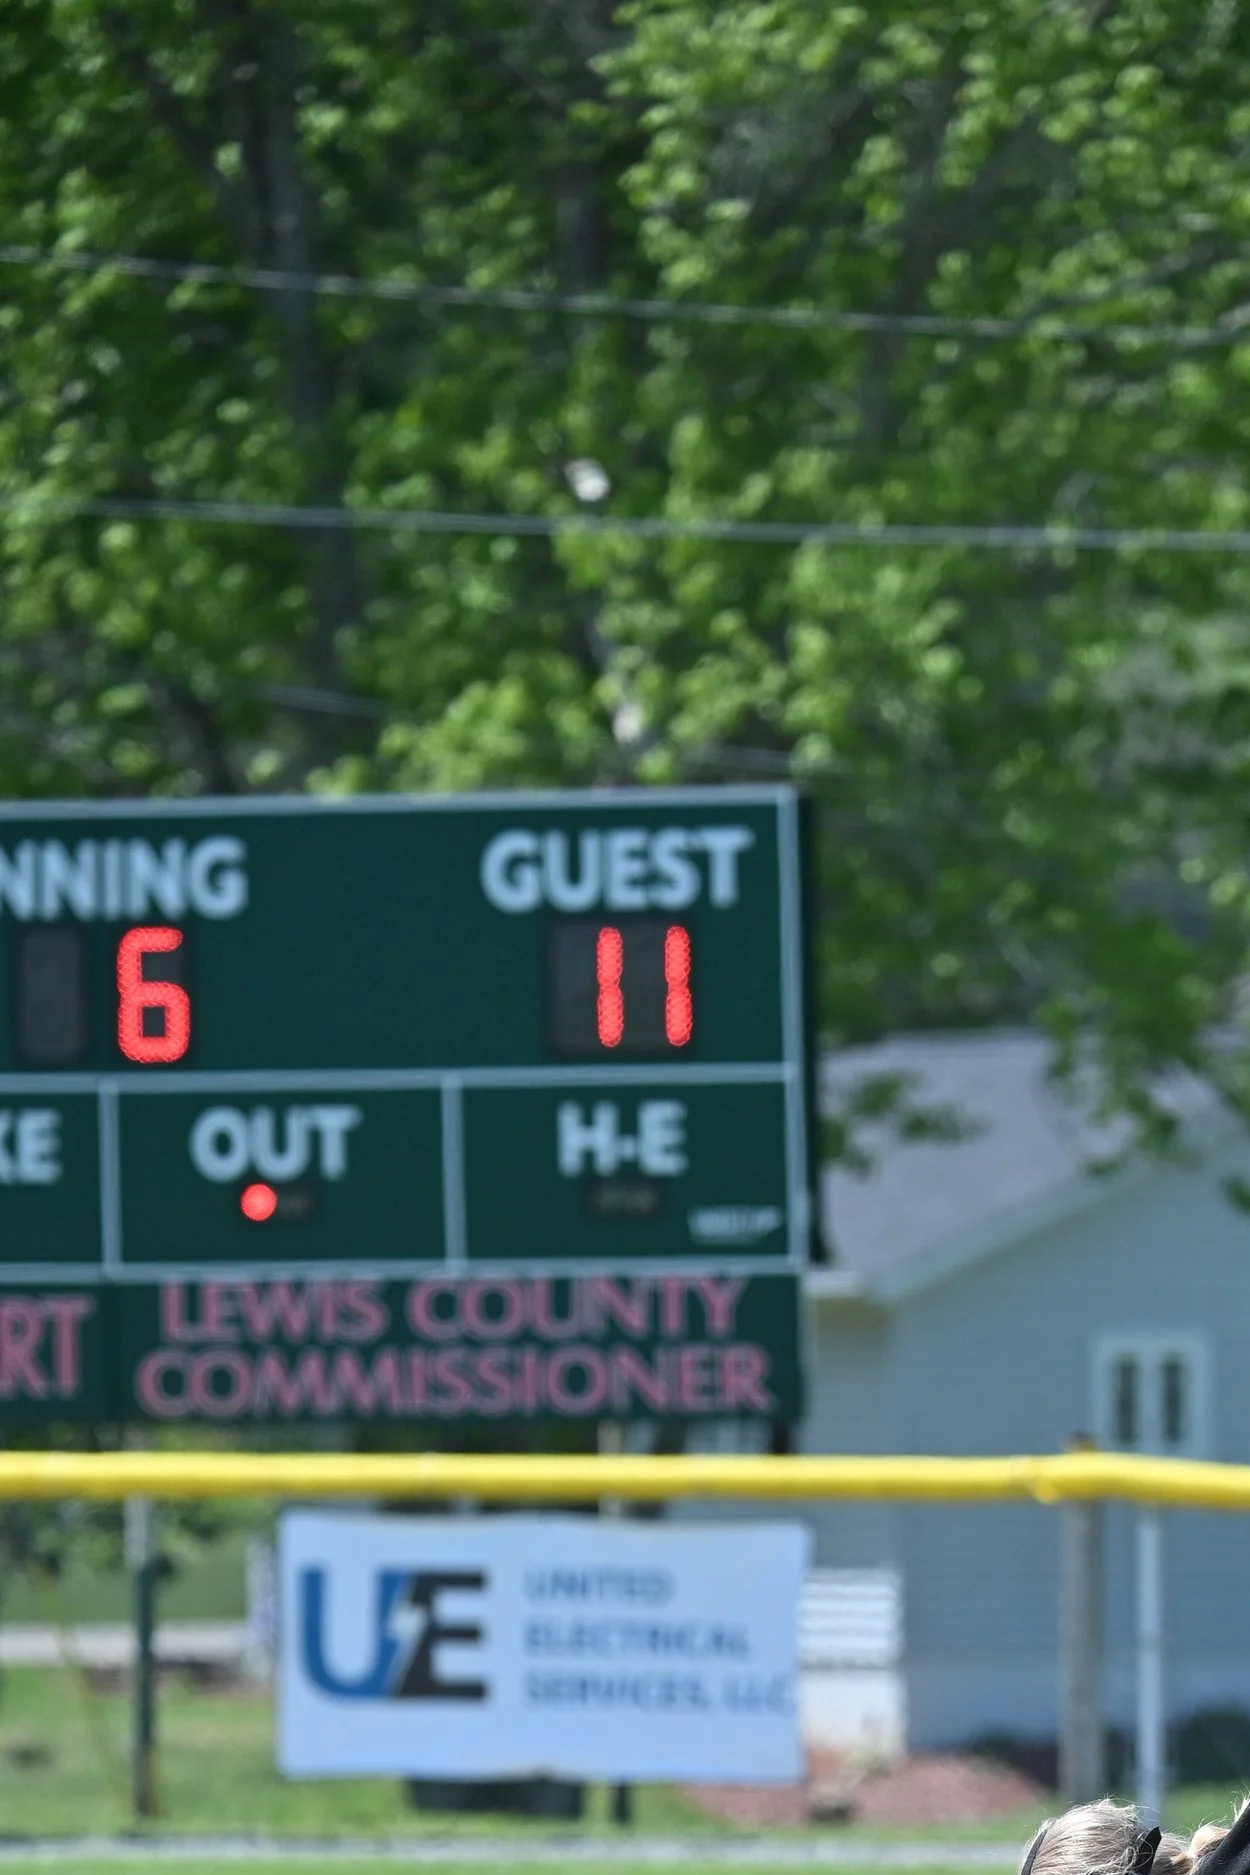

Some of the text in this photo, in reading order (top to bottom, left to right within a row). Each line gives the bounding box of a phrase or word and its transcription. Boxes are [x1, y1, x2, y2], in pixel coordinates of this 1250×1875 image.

[481, 826, 755, 912] GUEST
[116, 926, 191, 1064] 6
[597, 926, 693, 1047] 11
[190, 1105, 361, 1183] OUT
[160, 1275, 750, 1343] LEWIS COUNTY
[135, 1345, 776, 1417] COMMISSIONER
[524, 1567, 675, 1606] UNITED
[524, 1620, 749, 1661] ELECTRICAL
[722, 1678, 798, 1718] LLC
